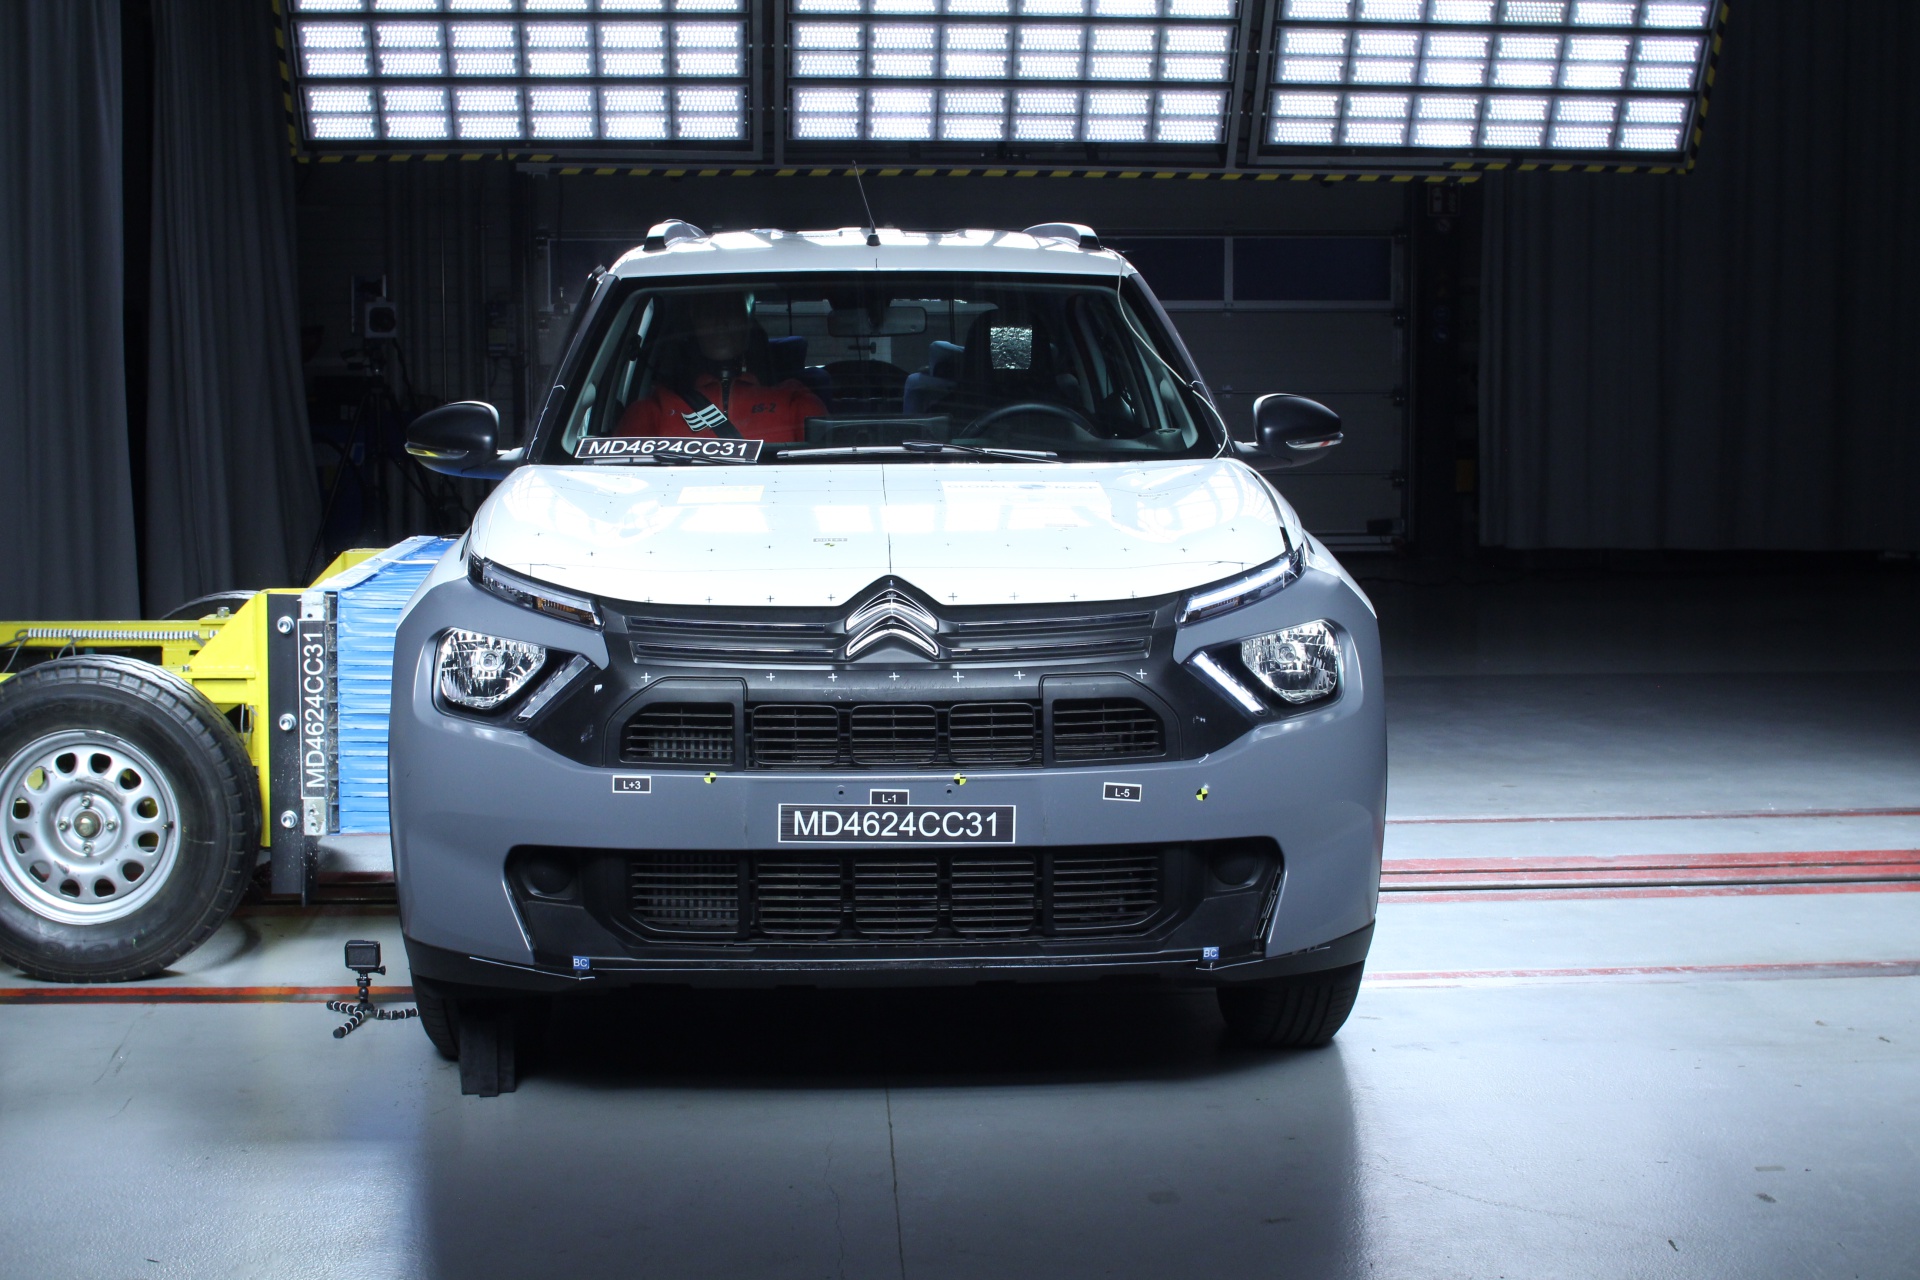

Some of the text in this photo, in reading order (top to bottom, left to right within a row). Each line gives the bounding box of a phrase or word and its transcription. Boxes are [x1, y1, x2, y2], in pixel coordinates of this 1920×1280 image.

[587, 440, 748, 457] MD4624CC31
[303, 632, 326, 788] MD4624CC31
[622, 780, 641, 790] L+3
[1114, 787, 1131, 798] L-5
[882, 793, 897, 803] L-1
[793, 810, 997, 838] MD4624CC31
[1203, 948, 1218, 958] BC
[573, 958, 588, 967] BC
